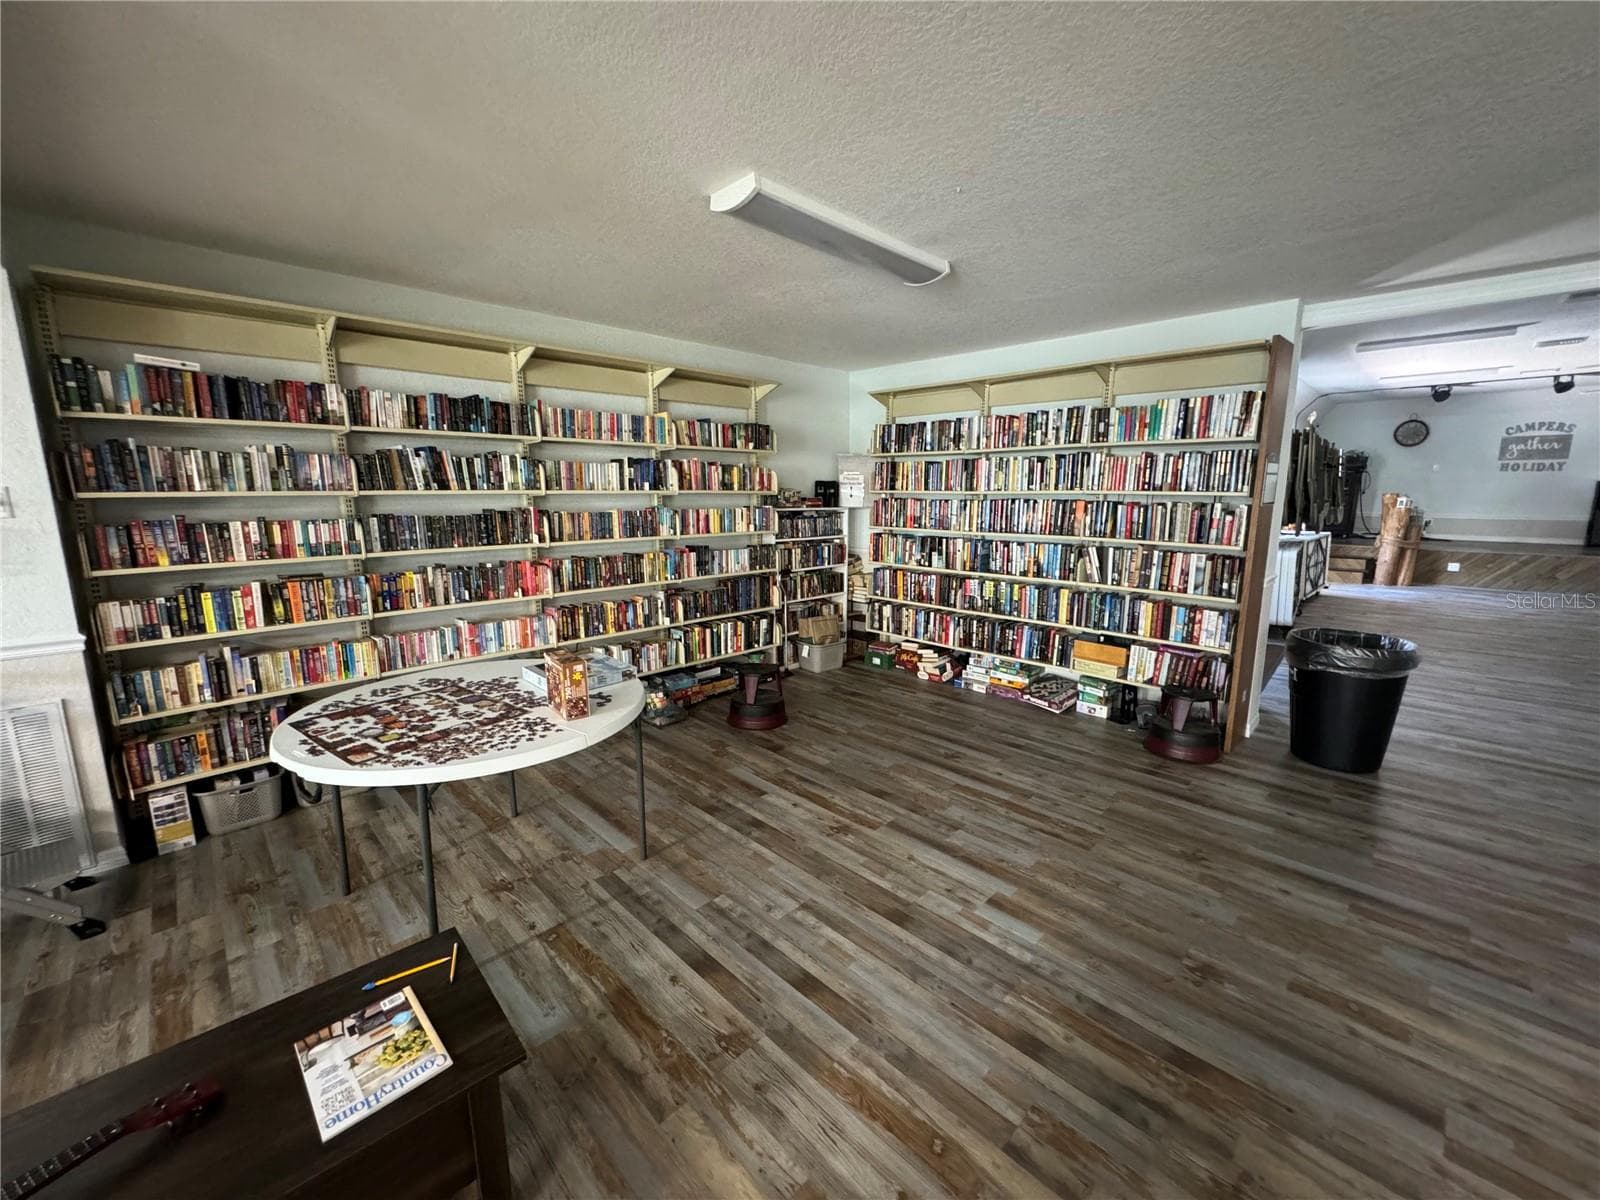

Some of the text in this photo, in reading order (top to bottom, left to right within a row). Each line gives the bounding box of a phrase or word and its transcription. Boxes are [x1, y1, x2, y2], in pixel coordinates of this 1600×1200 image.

[1505, 421, 1577, 436] CAMPERS
[1507, 437, 1561, 458] gather
[1499, 461, 1567, 472] HOLIDAY
